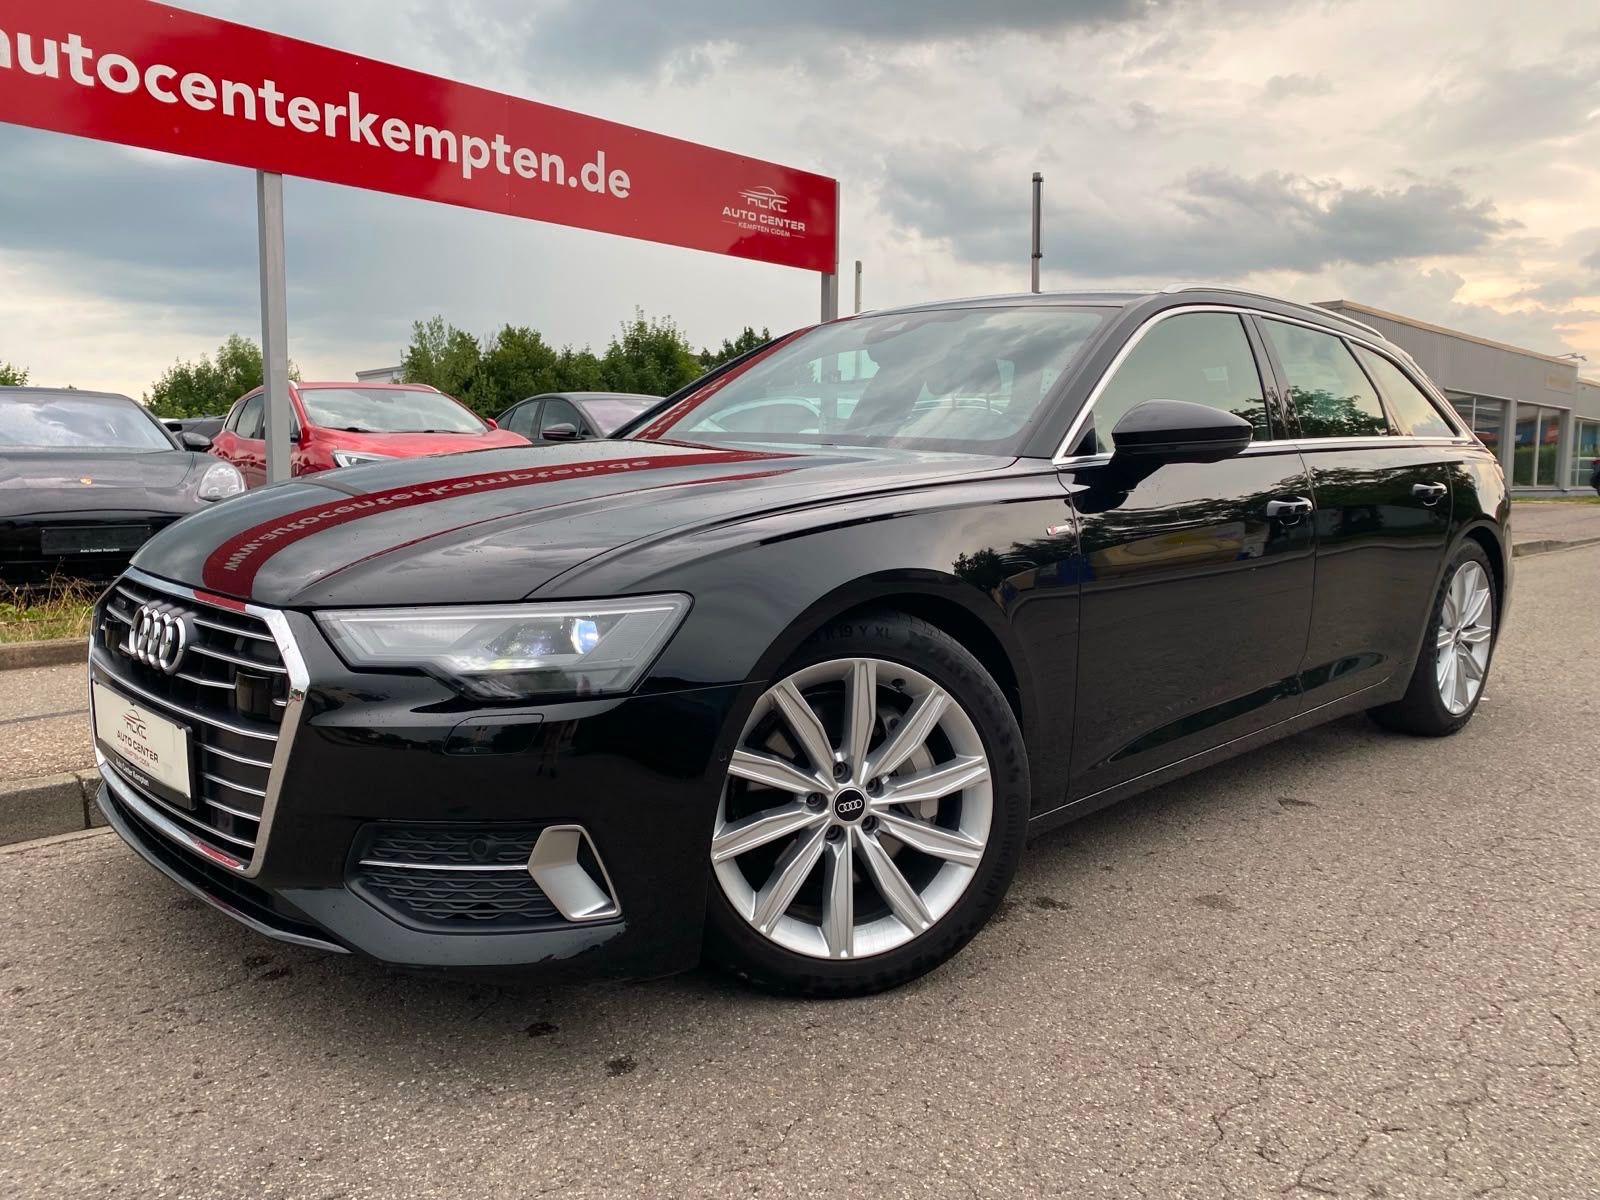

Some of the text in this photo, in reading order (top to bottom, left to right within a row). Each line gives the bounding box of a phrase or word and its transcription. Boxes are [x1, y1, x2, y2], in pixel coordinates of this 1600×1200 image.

[722, 206, 806, 232] AUTO CENTER
[738, 222, 769, 233] KEMPTEN
[117, 730, 133, 747] AUTO
[132, 740, 159, 763] CENTER
